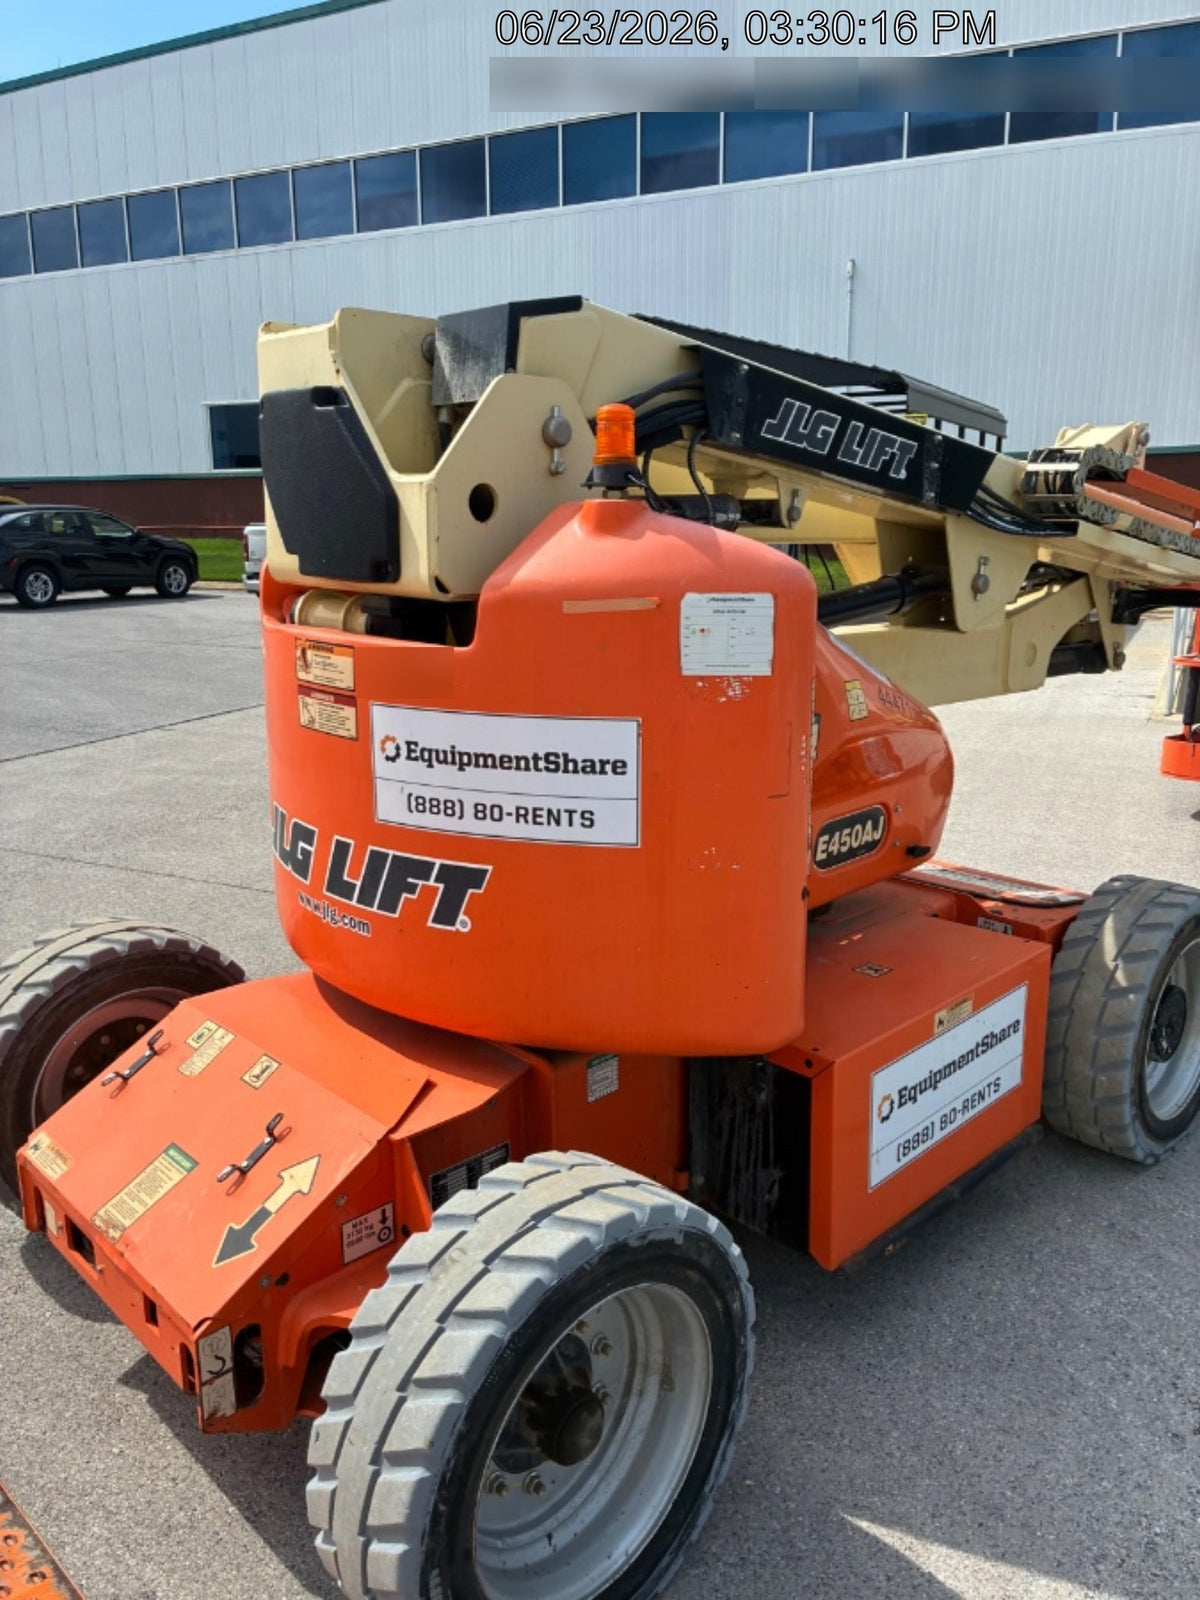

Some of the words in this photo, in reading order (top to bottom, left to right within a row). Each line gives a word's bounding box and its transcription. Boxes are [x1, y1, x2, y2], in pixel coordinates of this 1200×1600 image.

[760, 398, 842, 455] JLG
[837, 420, 918, 479] LIFT
[404, 740, 628, 776] EquipmentShare
[406, 792, 465, 820] (888)
[473, 802, 596, 829] 80-RENTS
[815, 815, 885, 861] E450AJ
[323, 834, 493, 931] LIFT
[896, 1018, 1021, 1110] EquipmentShare
[895, 1120, 935, 1163] (888)
[939, 1076, 1002, 1133] 80-RENTS
